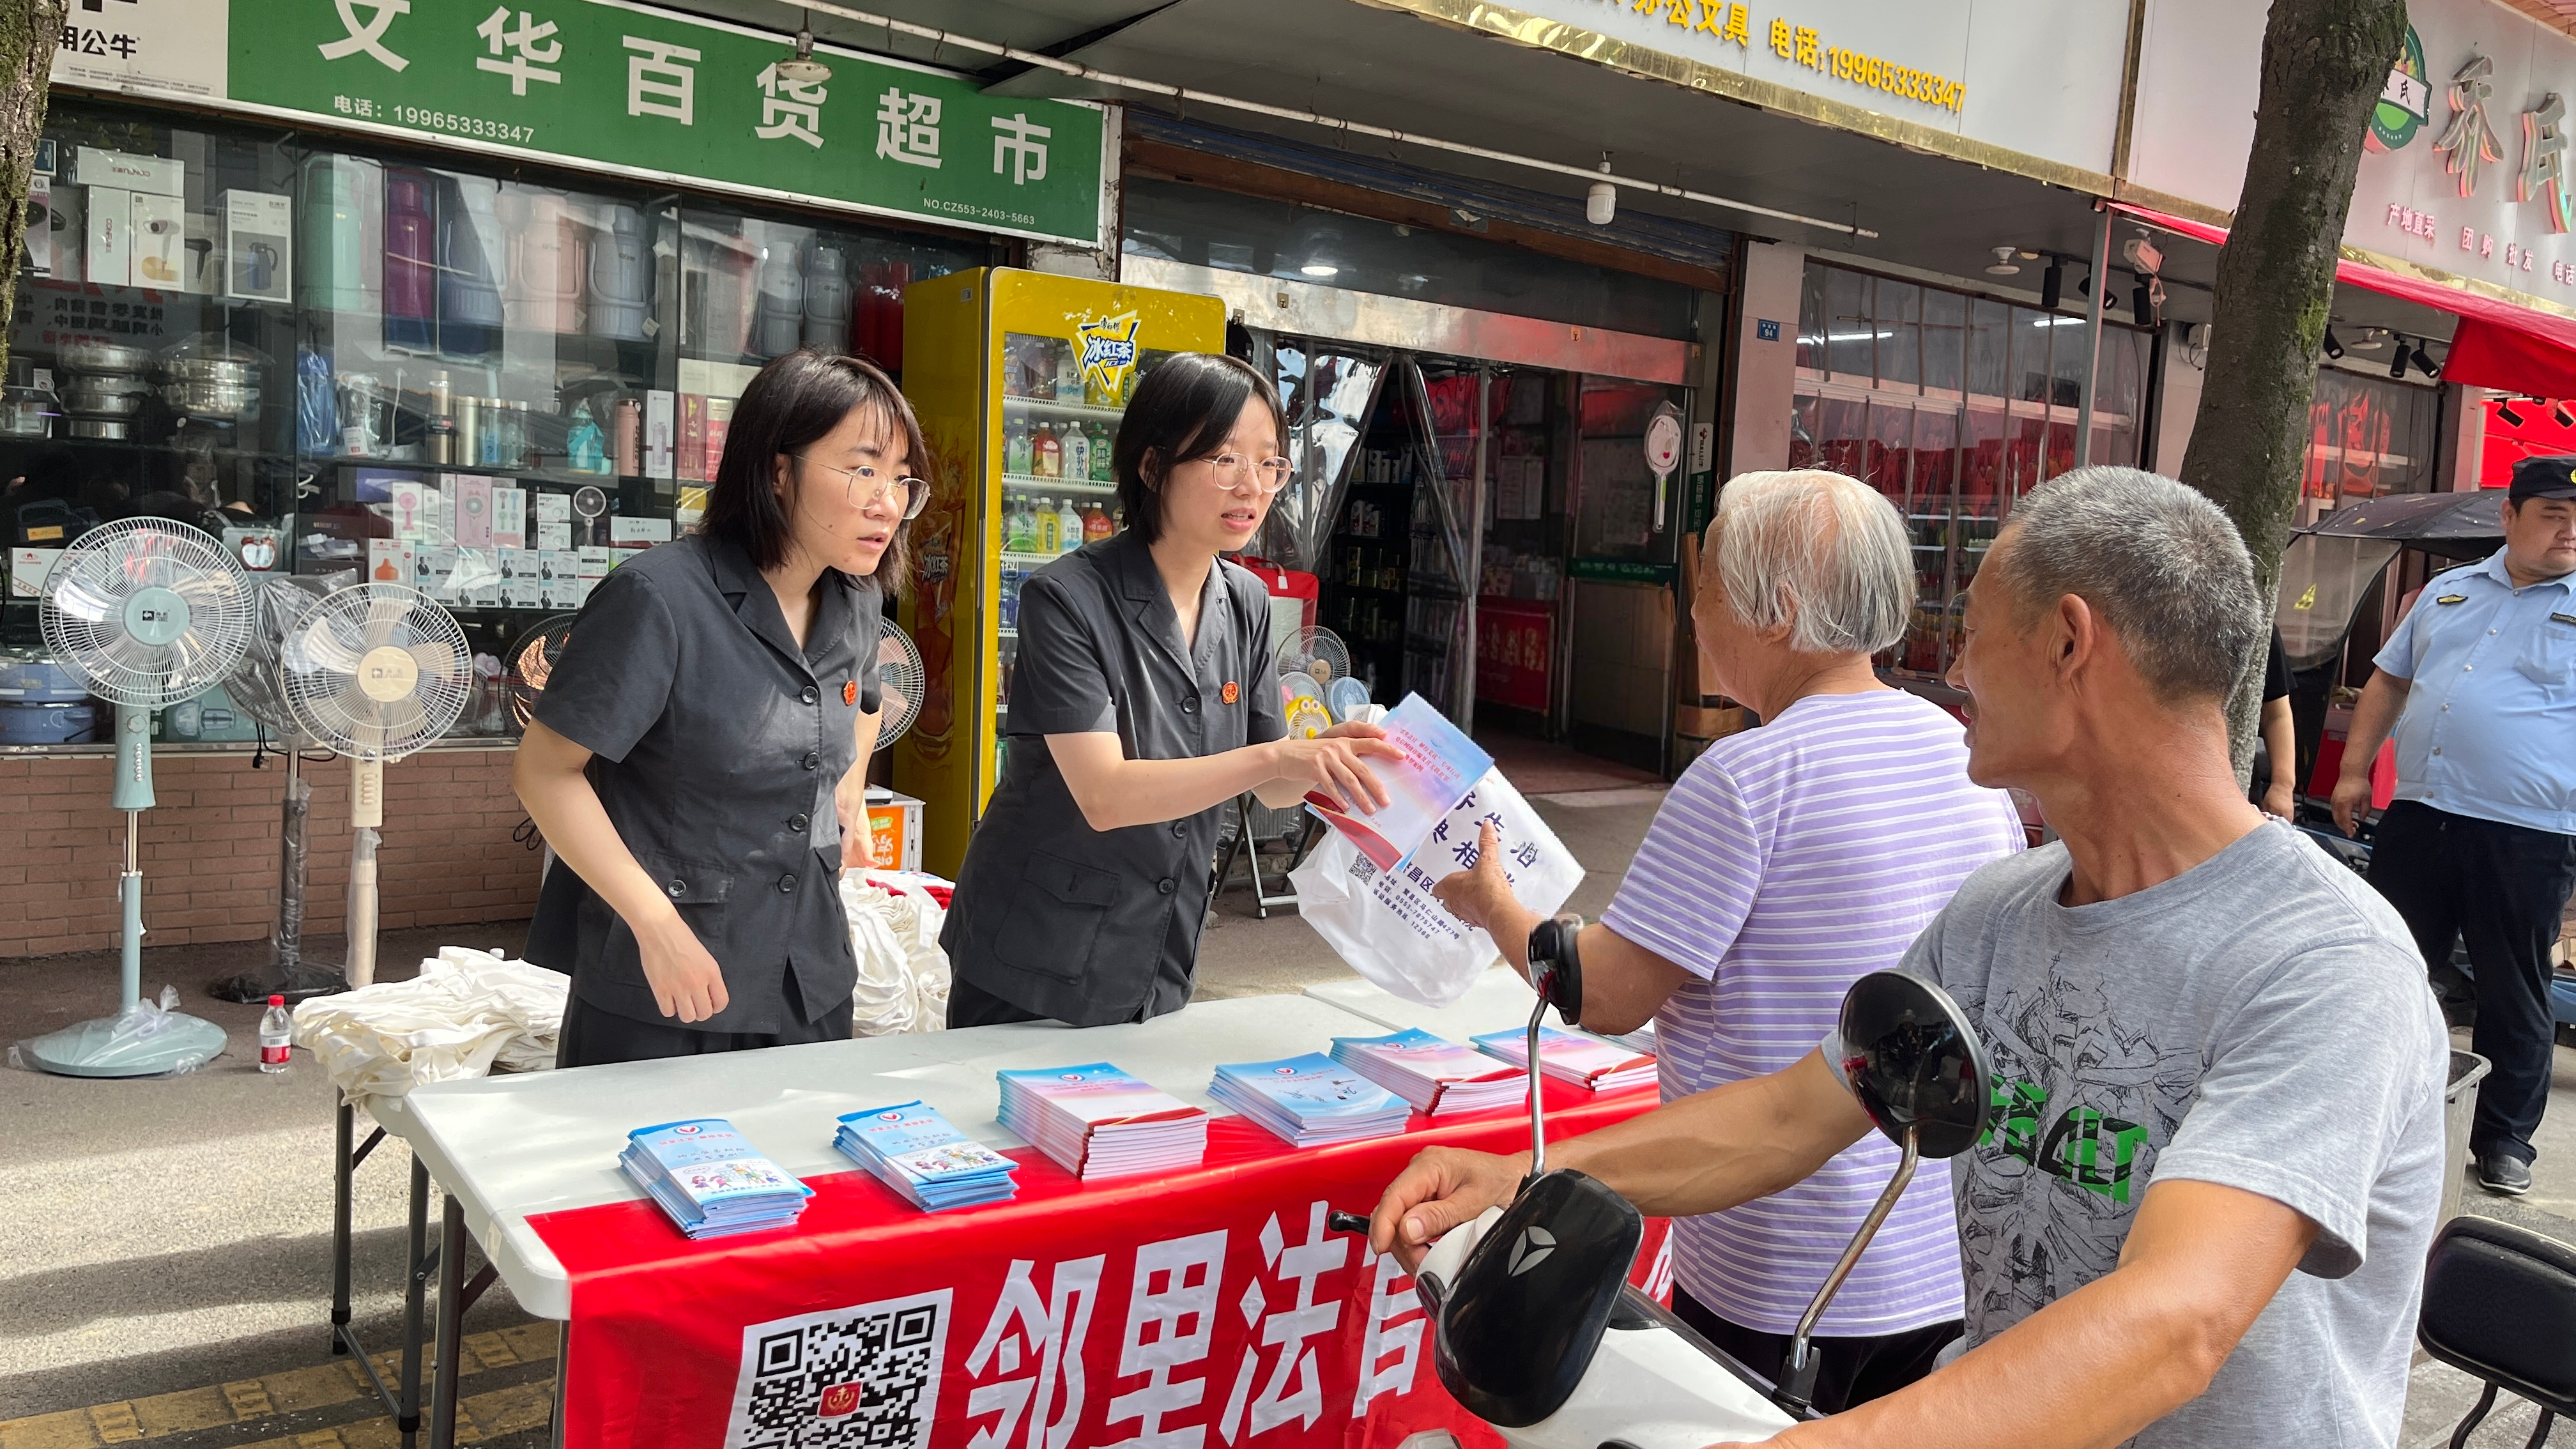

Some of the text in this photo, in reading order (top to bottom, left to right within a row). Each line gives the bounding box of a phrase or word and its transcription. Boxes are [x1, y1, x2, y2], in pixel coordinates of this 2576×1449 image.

[318, 0, 1052, 186] 文华百货超市
[923, 197, 1036, 226] NO.CZ553-2403-5663
[2388, 203, 2575, 286] 产地直采 团购 批发 电话
[1084, 335, 1133, 364] 冰红茶
[1765, 328, 1773, 337] 94
[965, 1199, 1427, 1449] 邻里法官
